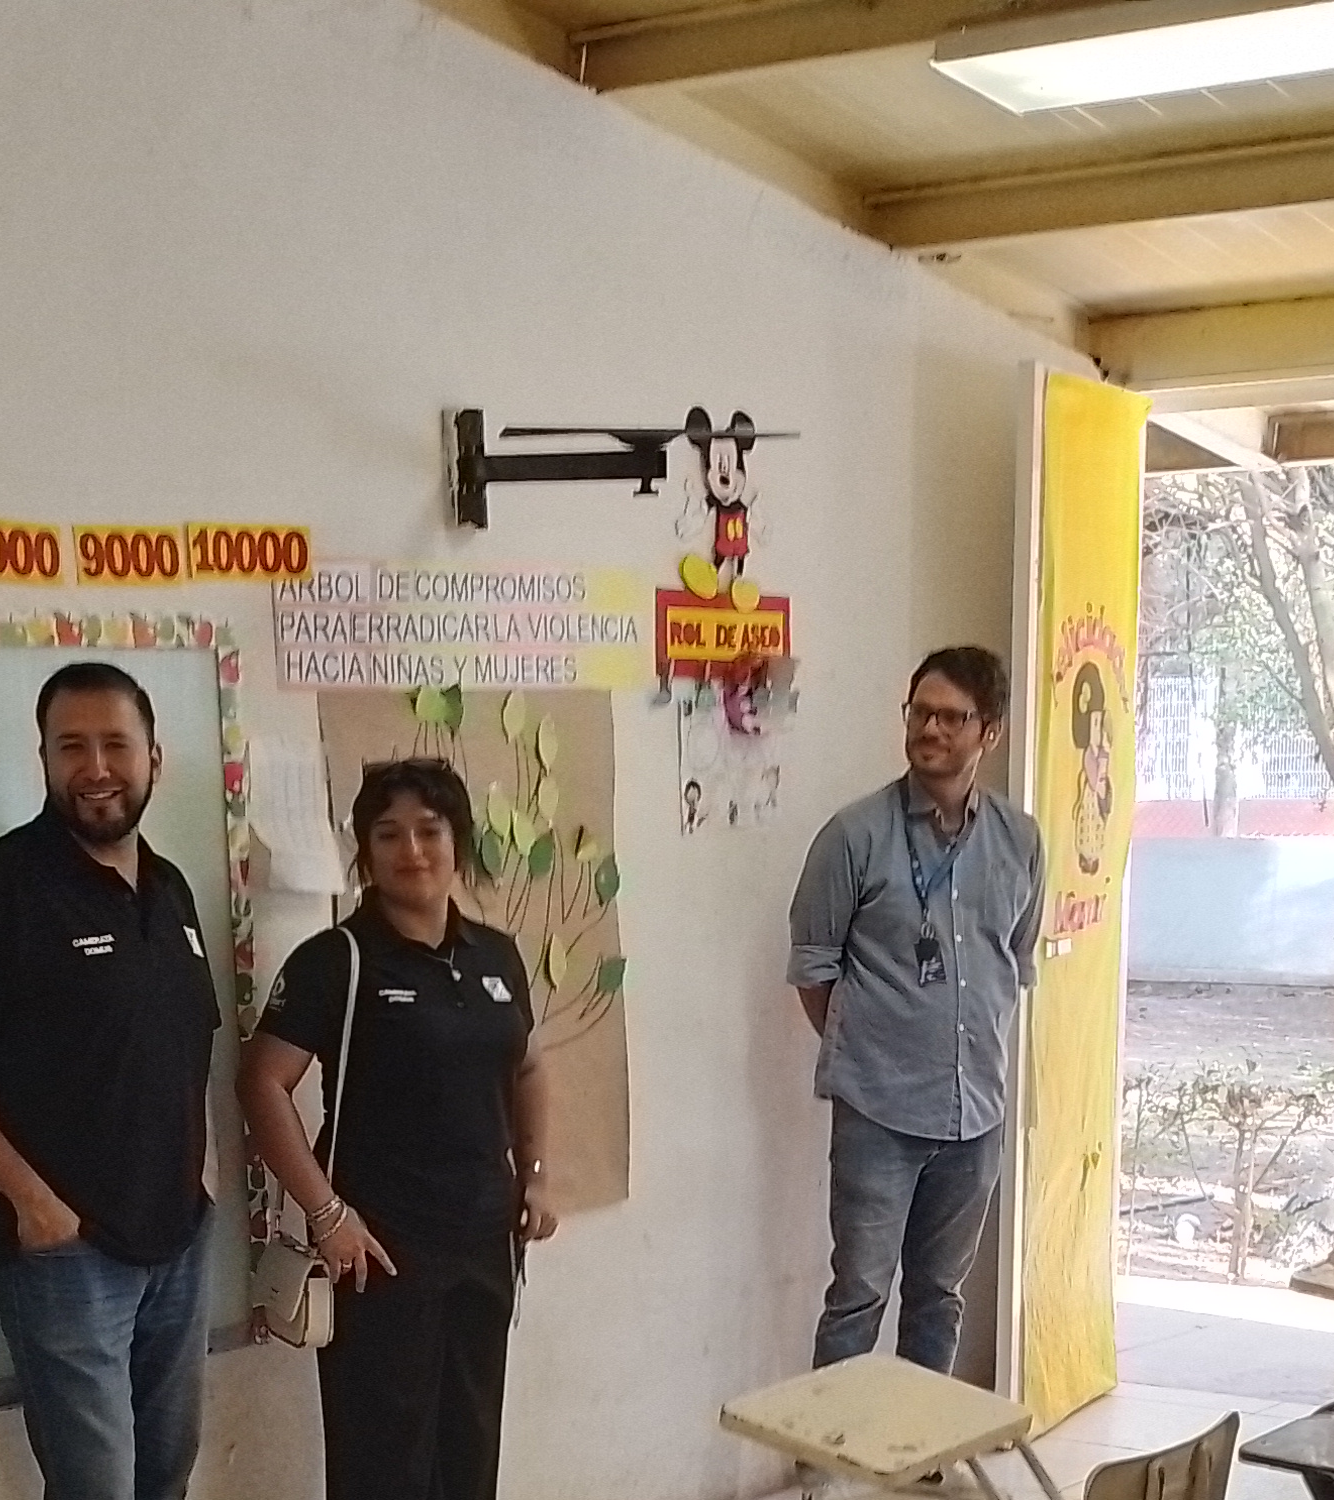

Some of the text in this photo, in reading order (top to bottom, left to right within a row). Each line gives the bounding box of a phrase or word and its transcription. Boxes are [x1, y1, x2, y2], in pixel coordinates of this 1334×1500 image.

[78, 532, 180, 578] 9000
[192, 526, 309, 576] 10000
[377, 571, 410, 601] DE
[416, 569, 586, 603] COMPROMISOS
[280, 611, 638, 644] PARA ERRADICAR LA VIOLENCIA
[715, 623, 737, 648] DE
[285, 650, 365, 683] HACIA
[454, 655, 468, 685] Y
[474, 653, 578, 684] MUJERES
